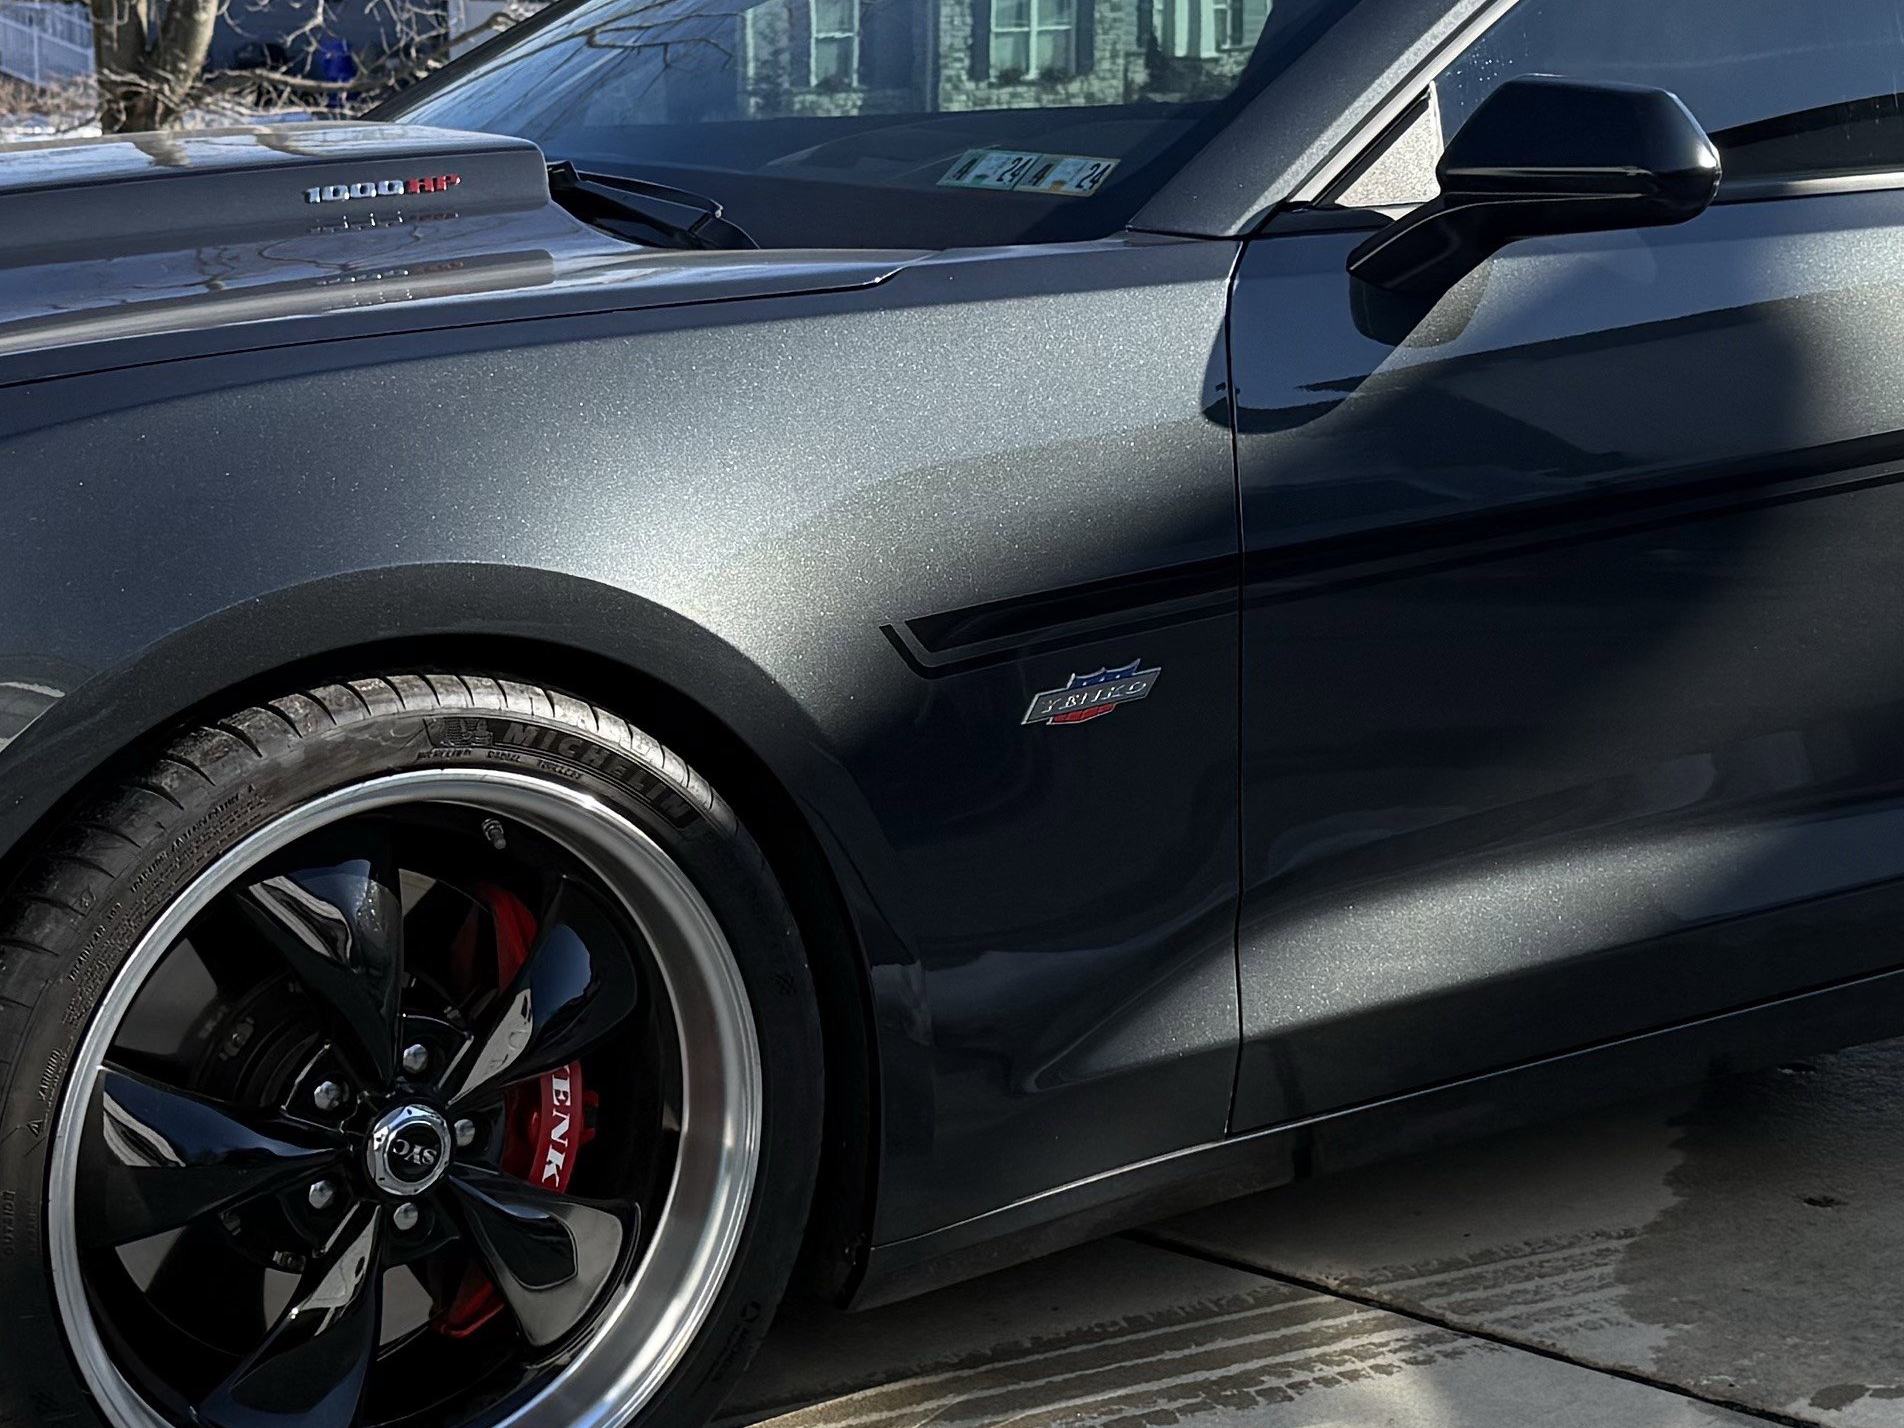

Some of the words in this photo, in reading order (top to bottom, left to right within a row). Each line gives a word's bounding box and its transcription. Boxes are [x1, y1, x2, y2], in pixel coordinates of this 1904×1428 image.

[996, 156, 1032, 183] 24
[1076, 163, 1111, 190] 24
[304, 173, 463, 204] 1000HP
[1040, 679, 1149, 714] YENKO
[503, 721, 694, 819] MICHELIN
[542, 1066, 571, 1188] ENK
[391, 1138, 438, 1166] SYC
